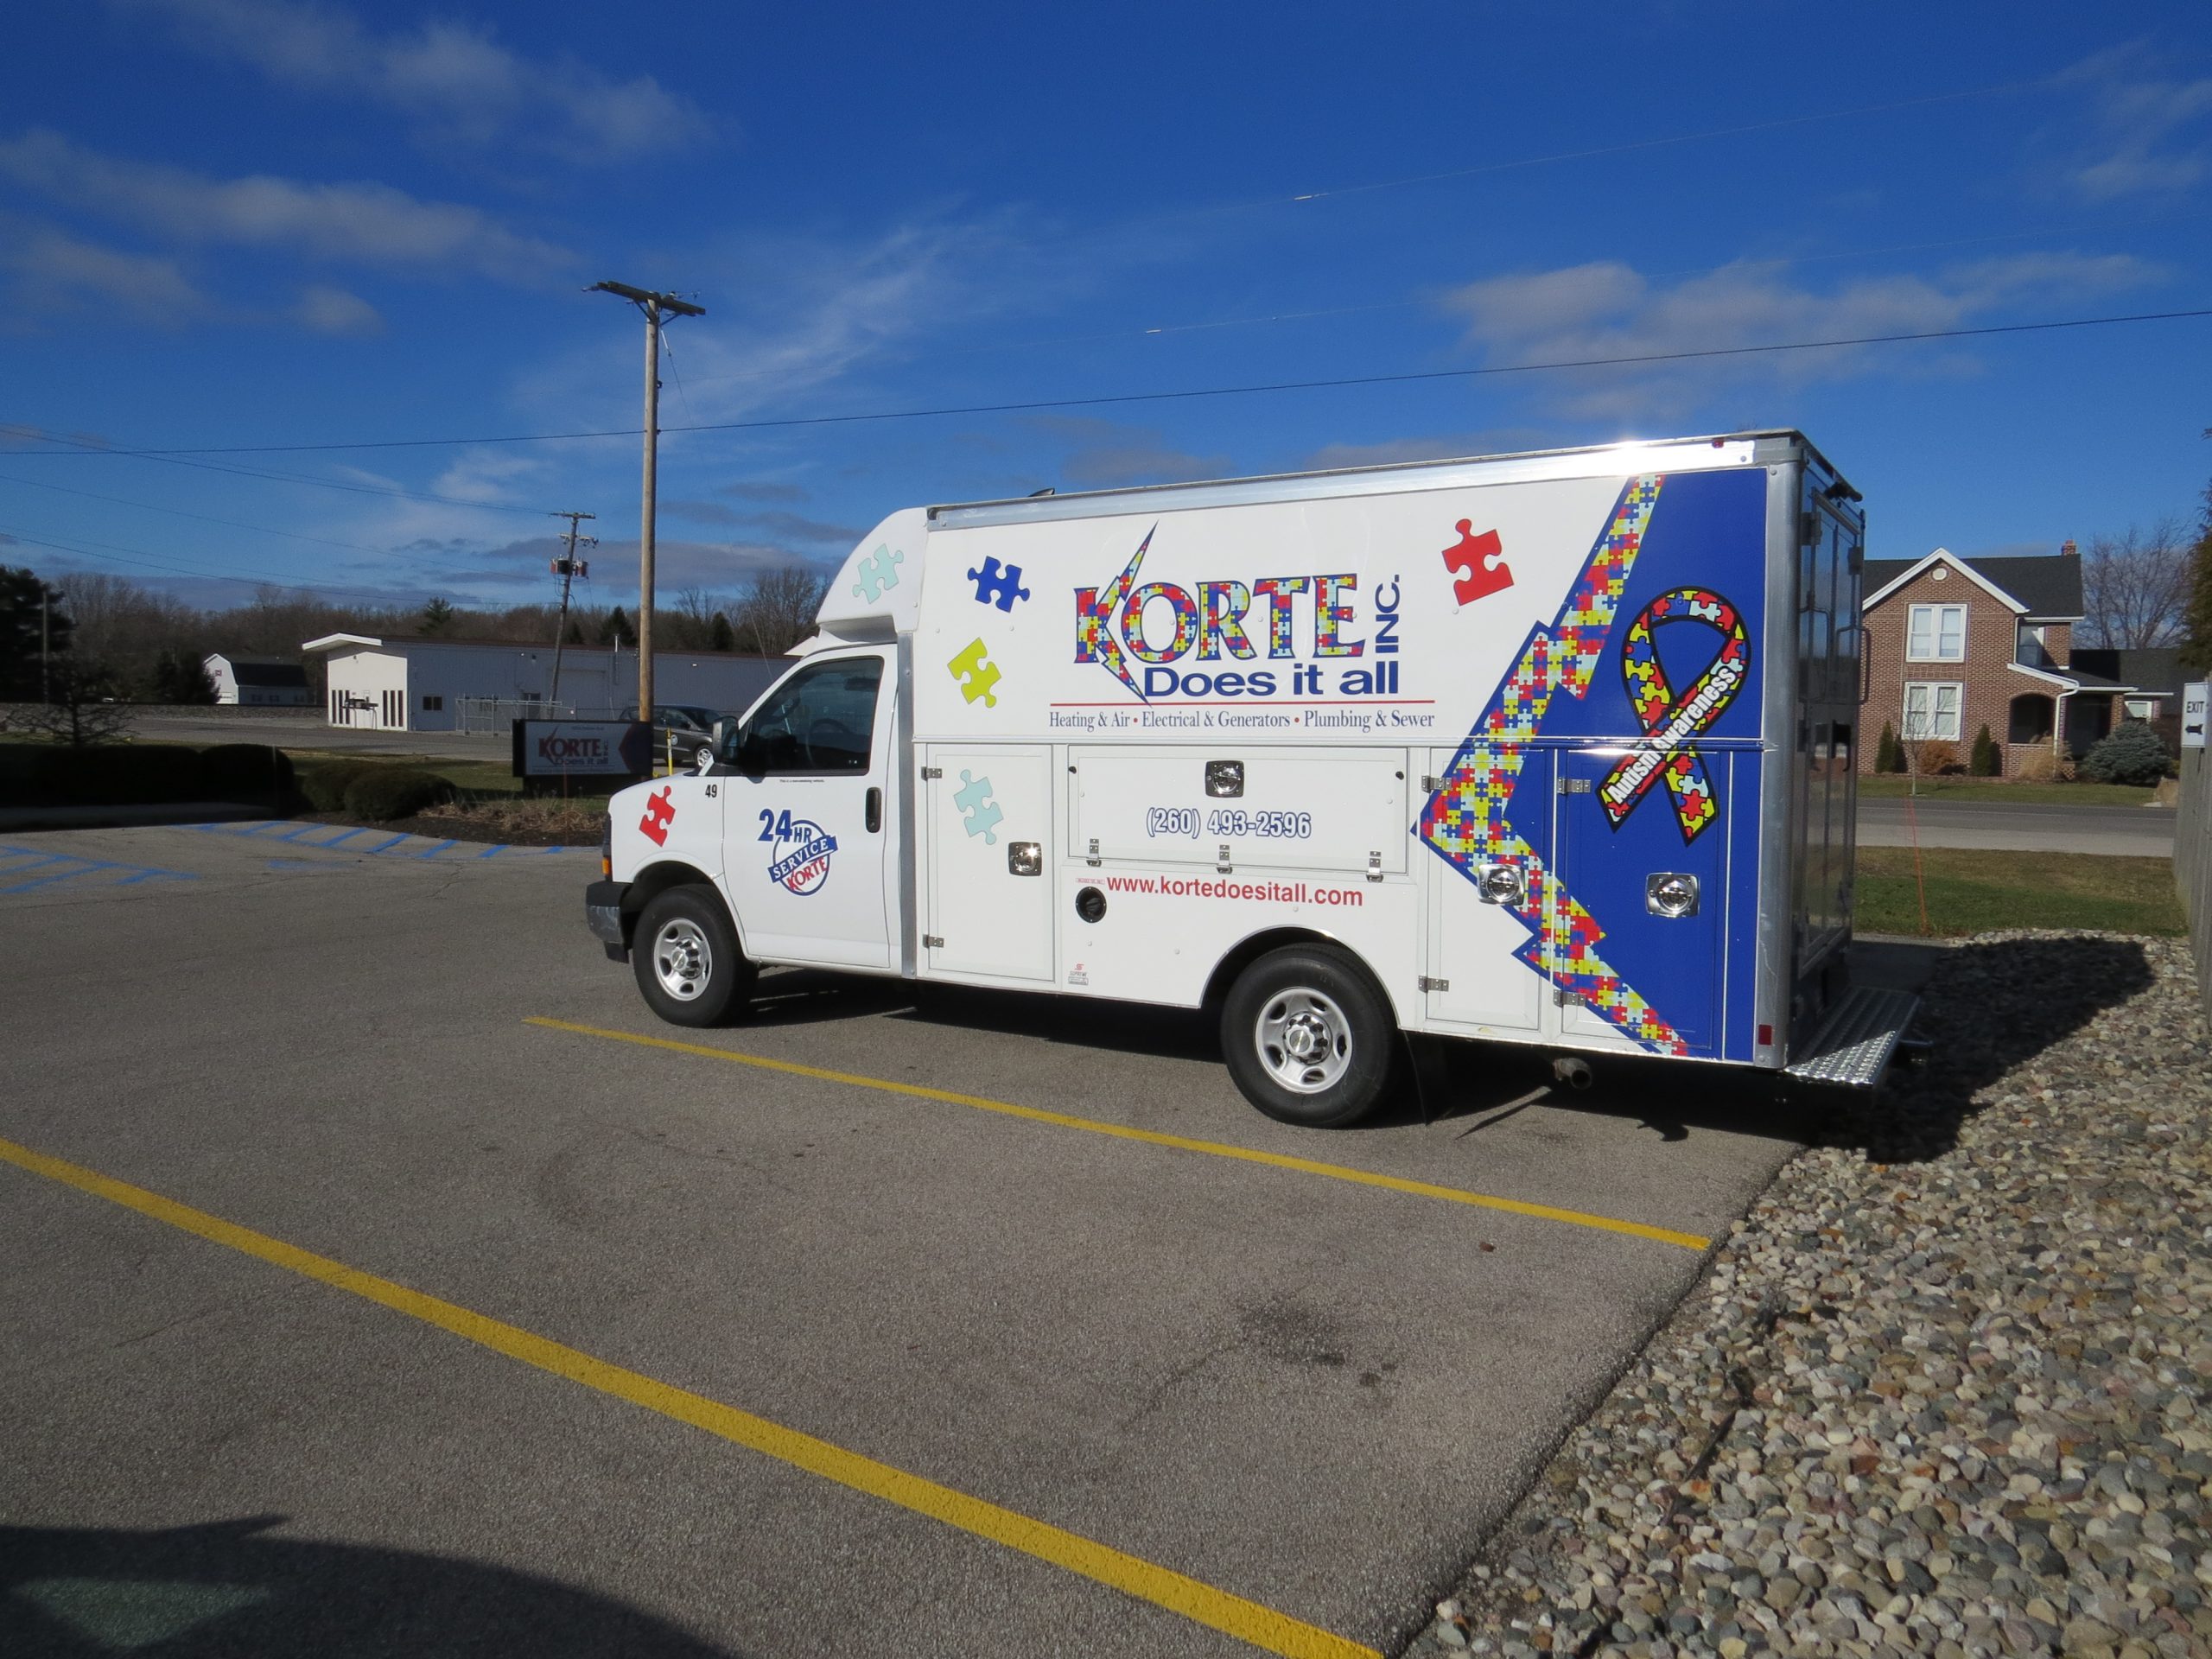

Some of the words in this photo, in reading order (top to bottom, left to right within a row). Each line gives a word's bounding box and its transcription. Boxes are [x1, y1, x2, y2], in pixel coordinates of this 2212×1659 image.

[1375, 575, 1400, 653] INC.
[1144, 666, 1277, 697] Does
[1294, 663, 1324, 695] it
[1339, 660, 1399, 695] all
[1049, 711, 1095, 733] Heating
[1097, 712, 1107, 727] &
[1111, 712, 1130, 727] Air
[1142, 711, 1200, 728] Electrical
[1204, 711, 1214, 727] &
[1217, 710, 1290, 728] Generators
[1304, 709, 1371, 733] Plumbing
[1376, 709, 1387, 727] &
[1391, 709, 1434, 728] Sewer
[2187, 701, 2204, 713] EXIT
[705, 784, 717, 798] 49
[1607, 750, 1662, 804] Autism
[758, 808, 792, 842] 24
[793, 827, 812, 842] HR
[1146, 807, 1201, 839] (260)
[1206, 810, 1312, 838] 493-2596
[773, 838, 829, 879] SERVICE
[786, 856, 827, 891] KORTE
[1107, 875, 1363, 906] www.kortedoesitall.com
